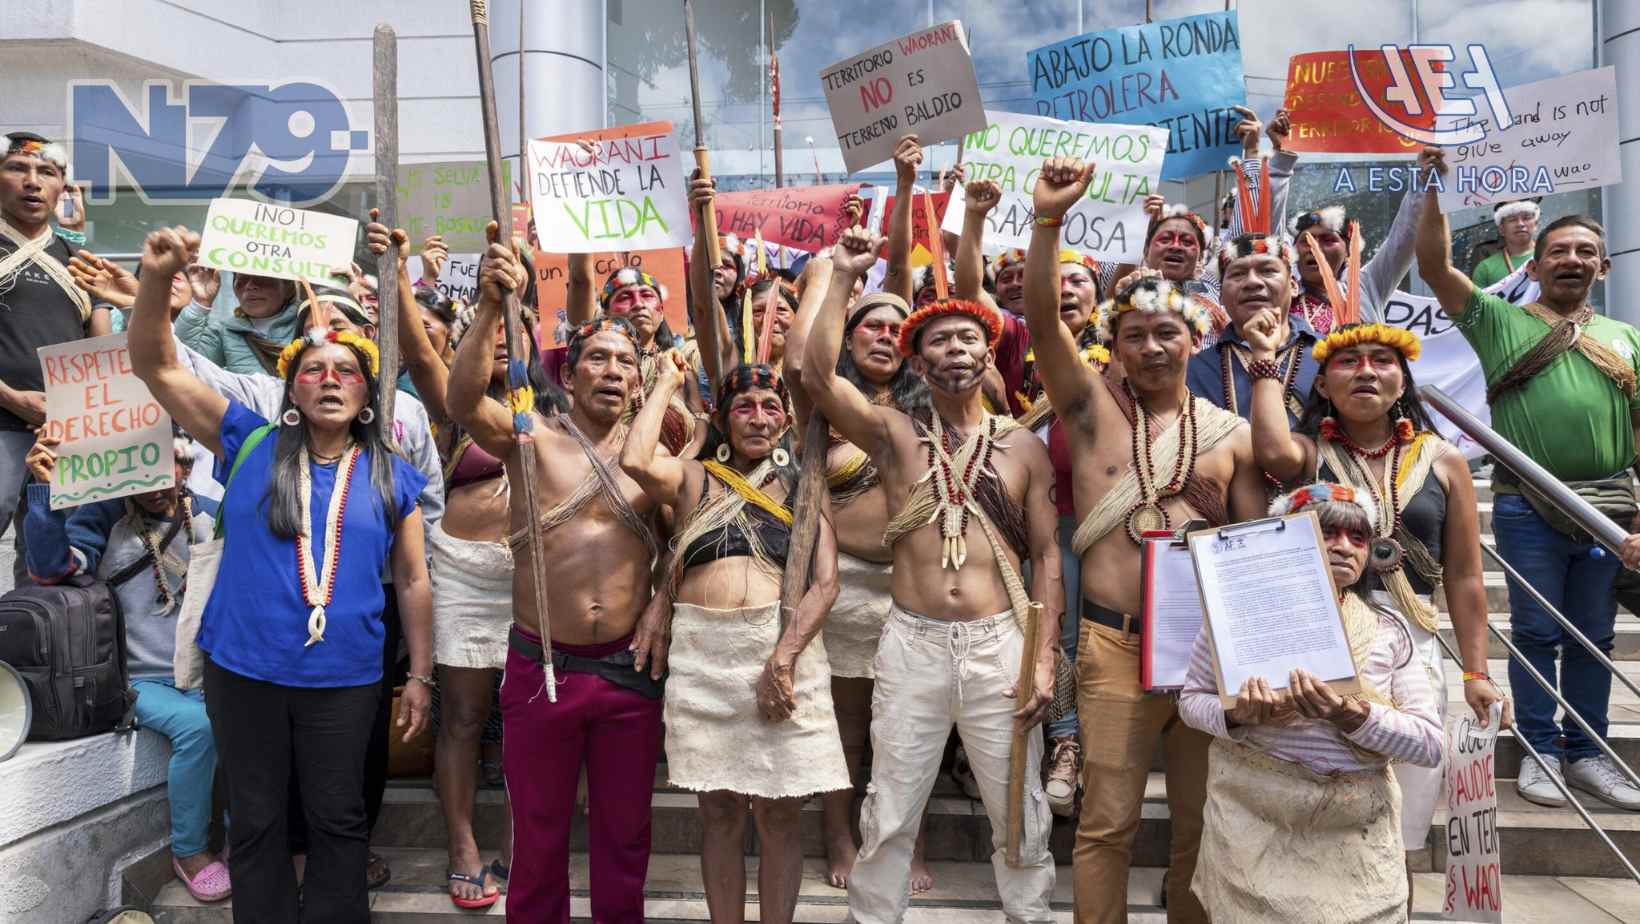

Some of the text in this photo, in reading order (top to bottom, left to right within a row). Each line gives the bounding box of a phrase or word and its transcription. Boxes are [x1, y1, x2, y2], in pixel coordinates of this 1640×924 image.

[822, 50, 893, 90] TERRITORIO
[1032, 18, 1241, 92] ABAJO LA RONDA
[860, 69, 925, 112] NO ES
[1036, 68, 1181, 121] PETROLERA
[838, 92, 963, 149] TERRENO BALDIO
[1145, 105, 1240, 154] IENTE
[1513, 101, 1541, 127] and
[965, 124, 1150, 163] NO QUEREMOS
[1521, 130, 1571, 148] away
[537, 164, 665, 199] DEFIENDE LA
[961, 161, 1150, 205] OTRA CULTA
[211, 216, 328, 250] QUEREMOS
[563, 195, 670, 239] VIDA
[730, 209, 769, 233] HAY
[780, 215, 826, 247] VIDA
[207, 247, 336, 280] CONSULT
[246, 242, 292, 259] OTRA
[85, 383, 121, 410] EL
[48, 403, 160, 443] DERECHO
[56, 442, 160, 486] PROPIO
[1448, 816, 1470, 857] EN
